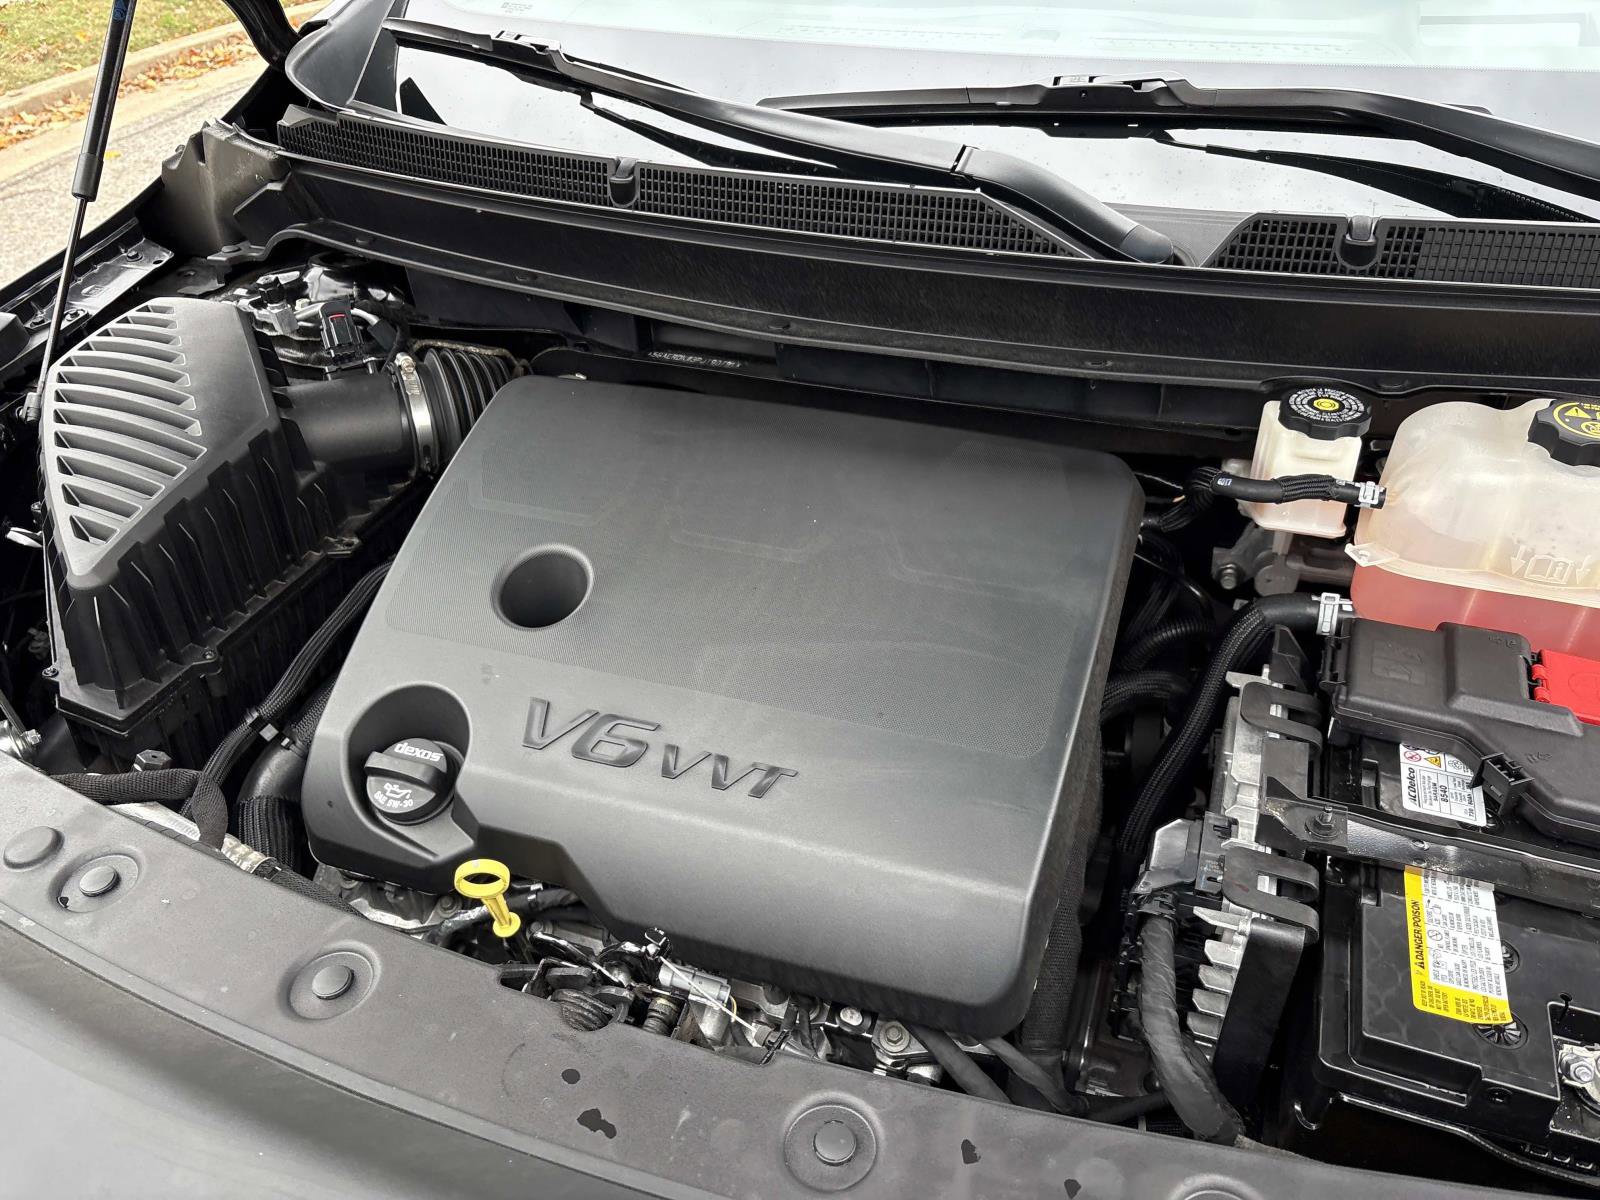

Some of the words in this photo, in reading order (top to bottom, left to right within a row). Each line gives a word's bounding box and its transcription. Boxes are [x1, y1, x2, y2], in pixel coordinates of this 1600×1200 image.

[394, 742, 444, 761] dexos
[522, 697, 660, 768] V6
[661, 744, 798, 798] VVT
[1407, 767, 1417, 806] ACDelco
[387, 799, 414, 808] 5W-30
